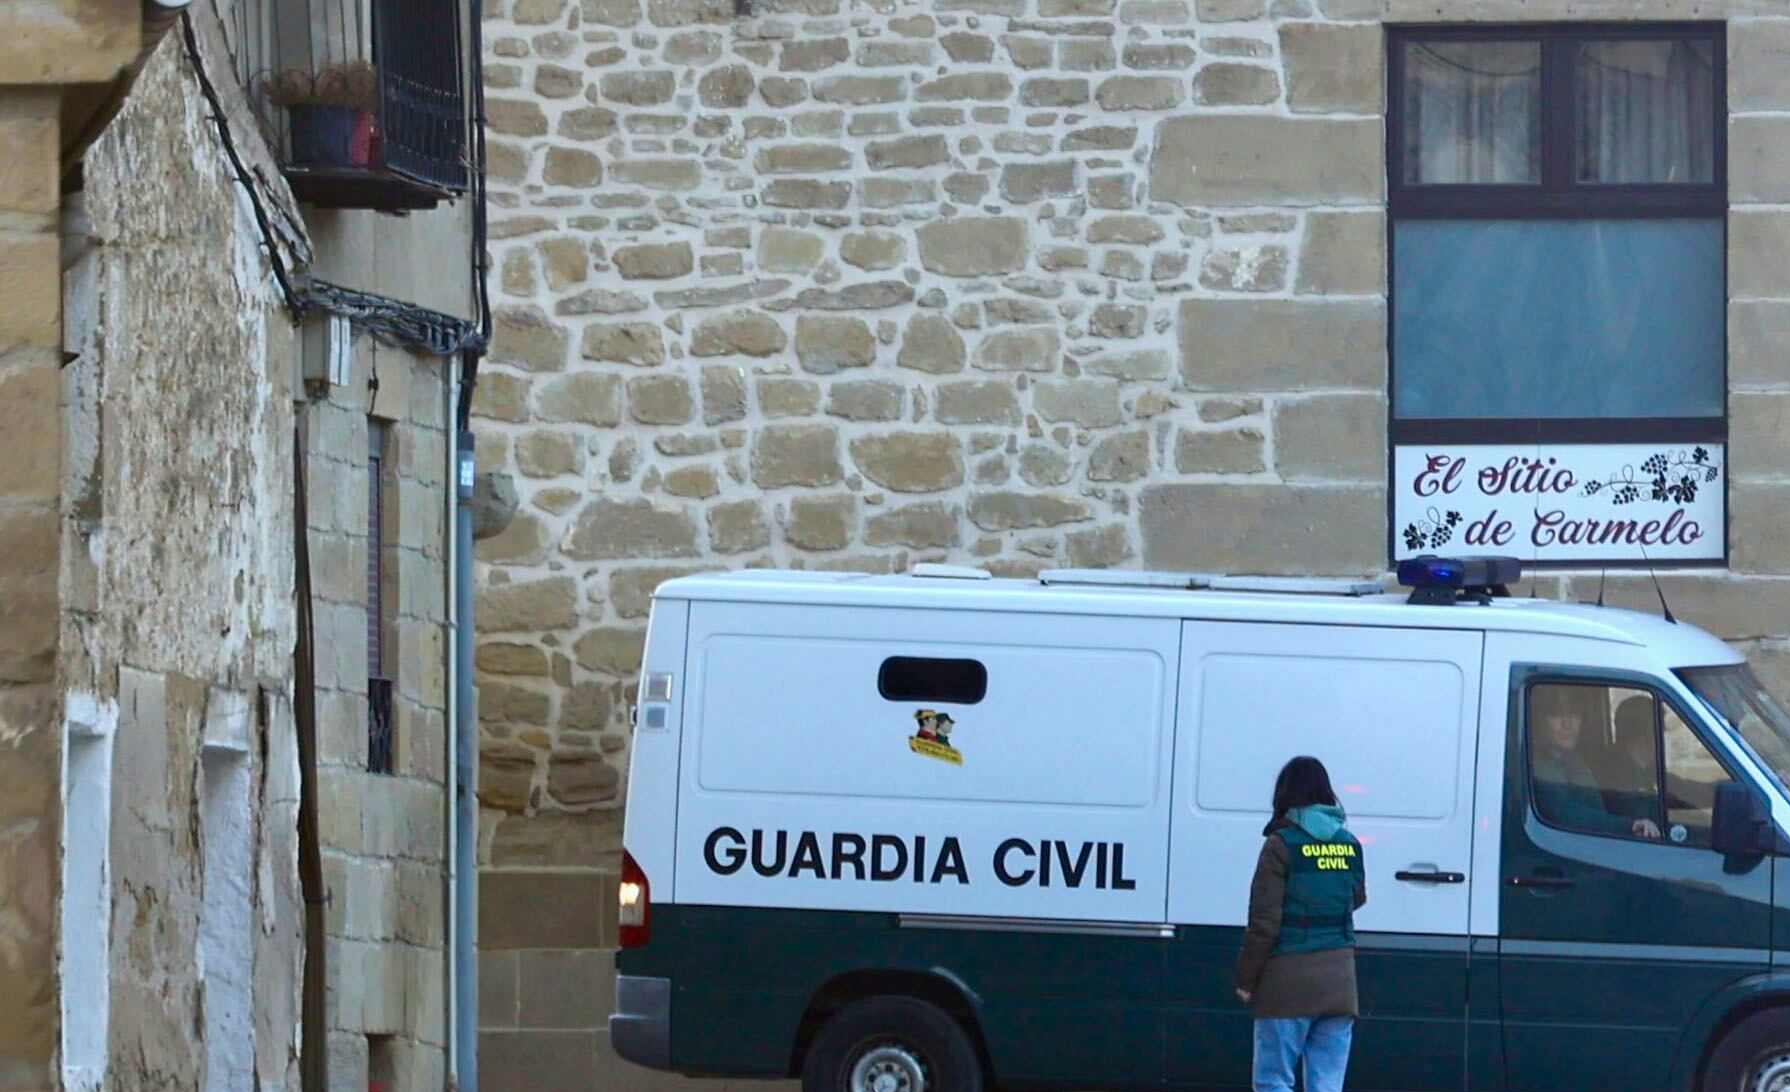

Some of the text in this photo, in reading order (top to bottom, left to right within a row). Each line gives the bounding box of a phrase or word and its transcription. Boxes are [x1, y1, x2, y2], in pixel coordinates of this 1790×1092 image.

[1413, 453, 1579, 497] El Sitio
[1463, 507, 1705, 547] de Carmelo
[703, 826, 1137, 890] GUARDIA CIVIL
[1302, 844, 1356, 858] GUARDIA
[1316, 857, 1349, 870] CIVIL
